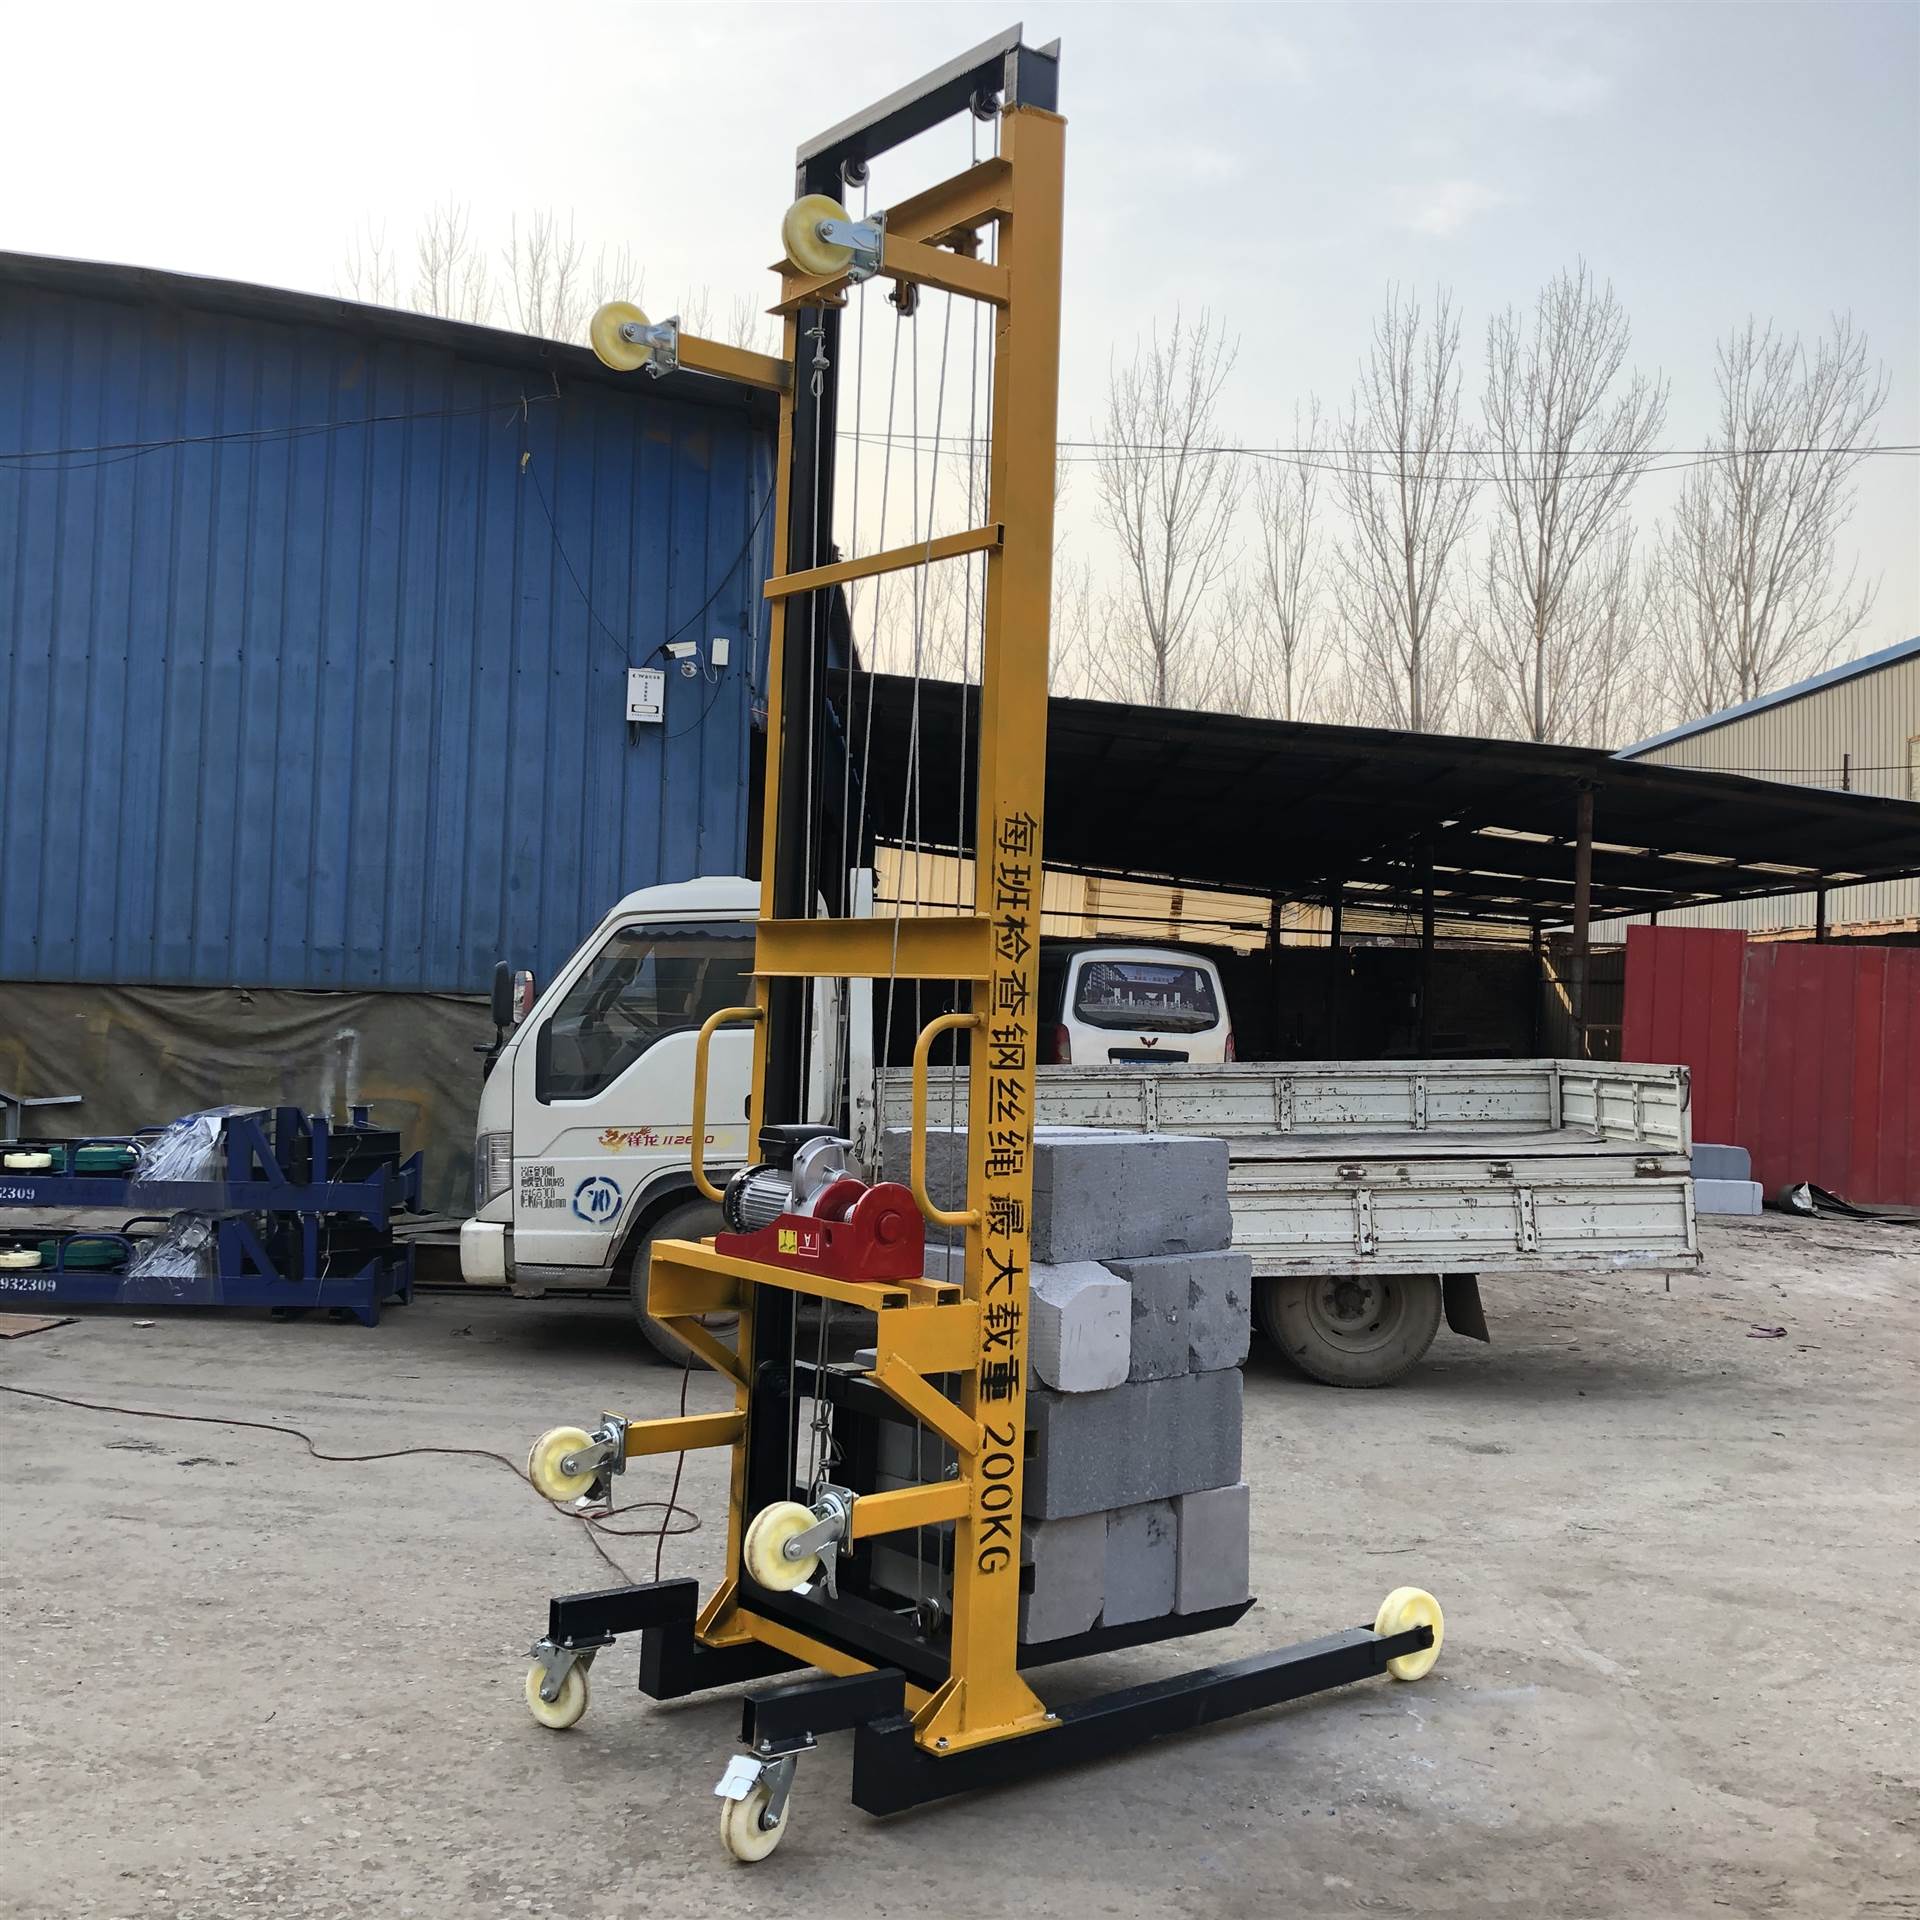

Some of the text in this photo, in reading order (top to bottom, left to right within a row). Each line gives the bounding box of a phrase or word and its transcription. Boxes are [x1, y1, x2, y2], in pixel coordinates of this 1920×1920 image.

[0, 1277, 57, 1292] 932309
[977, 810, 1039, 1576] 每班检查钢丝绳 最大载重 200KG
